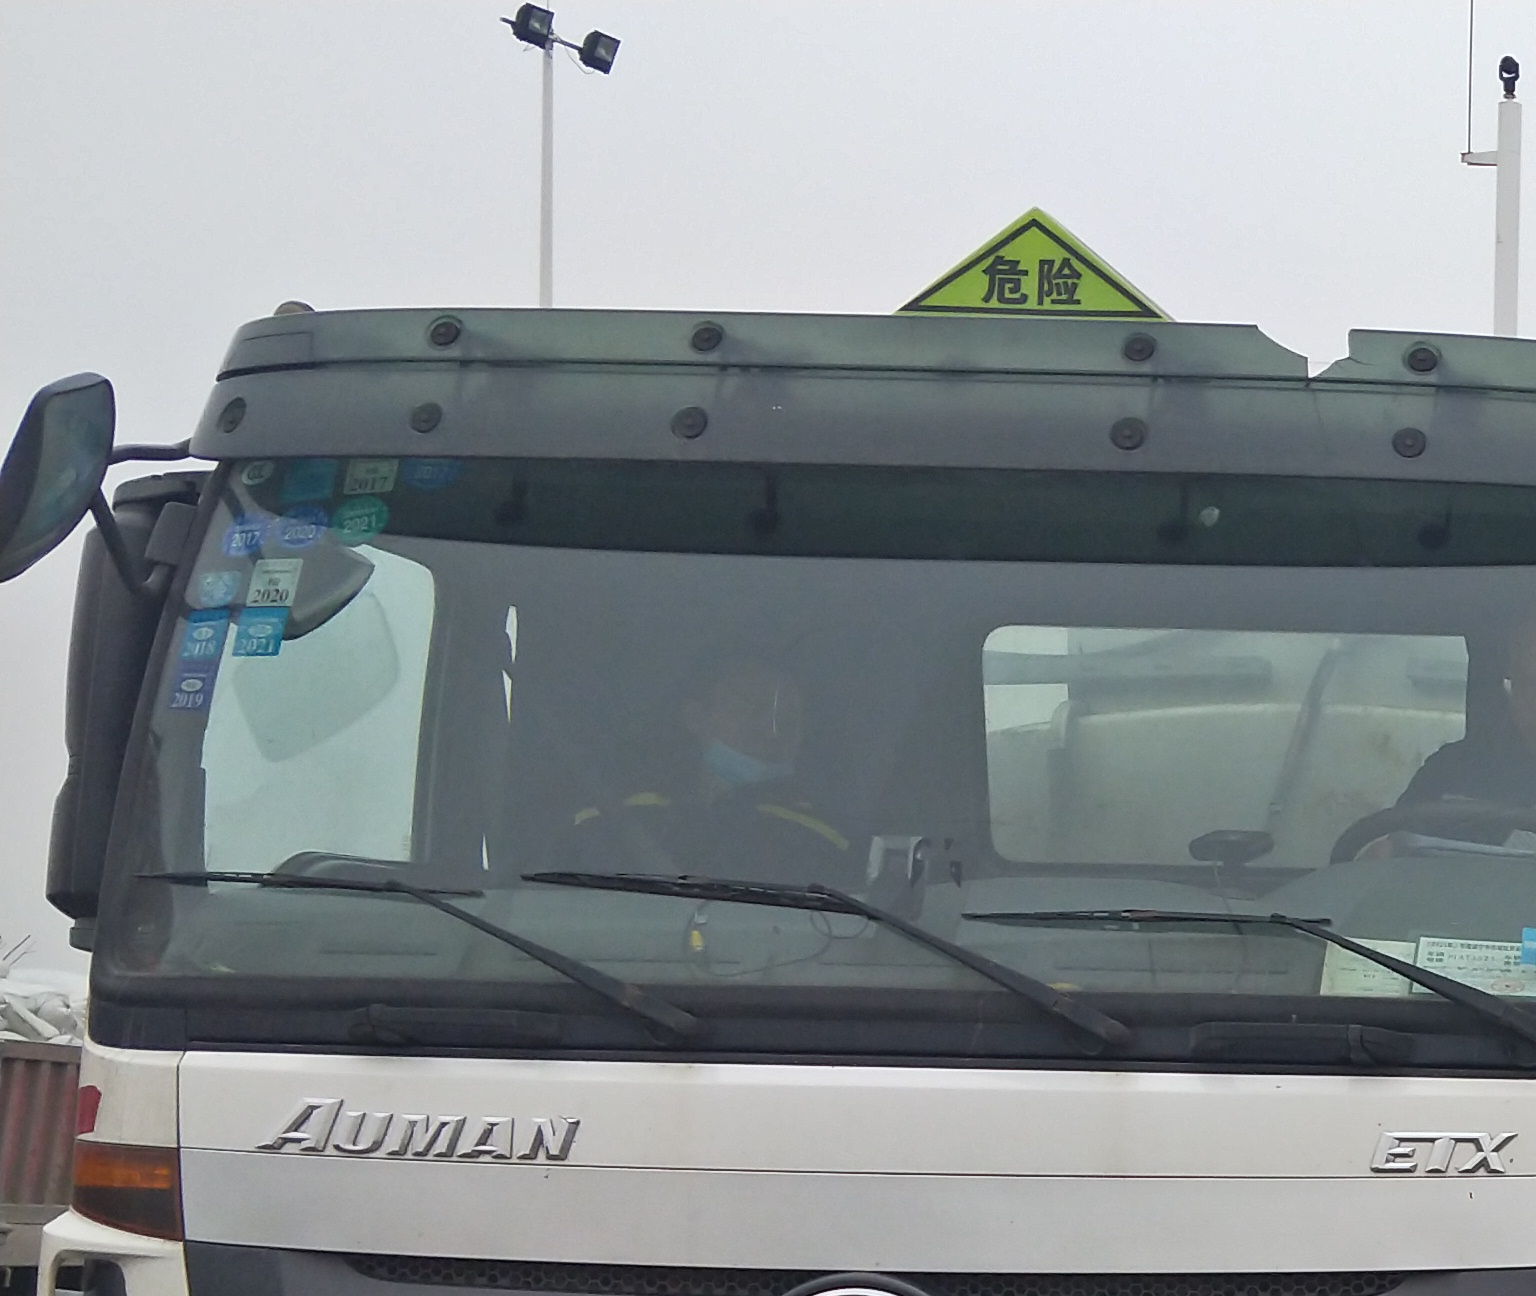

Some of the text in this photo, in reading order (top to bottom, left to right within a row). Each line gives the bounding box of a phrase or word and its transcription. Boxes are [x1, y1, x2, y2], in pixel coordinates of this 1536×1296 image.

[982, 255, 1083, 306] 危险
[343, 514, 377, 535] 2021
[250, 588, 290, 604] 2020
[170, 691, 205, 709] 2019
[1370, 1131, 1519, 1174] ETX
